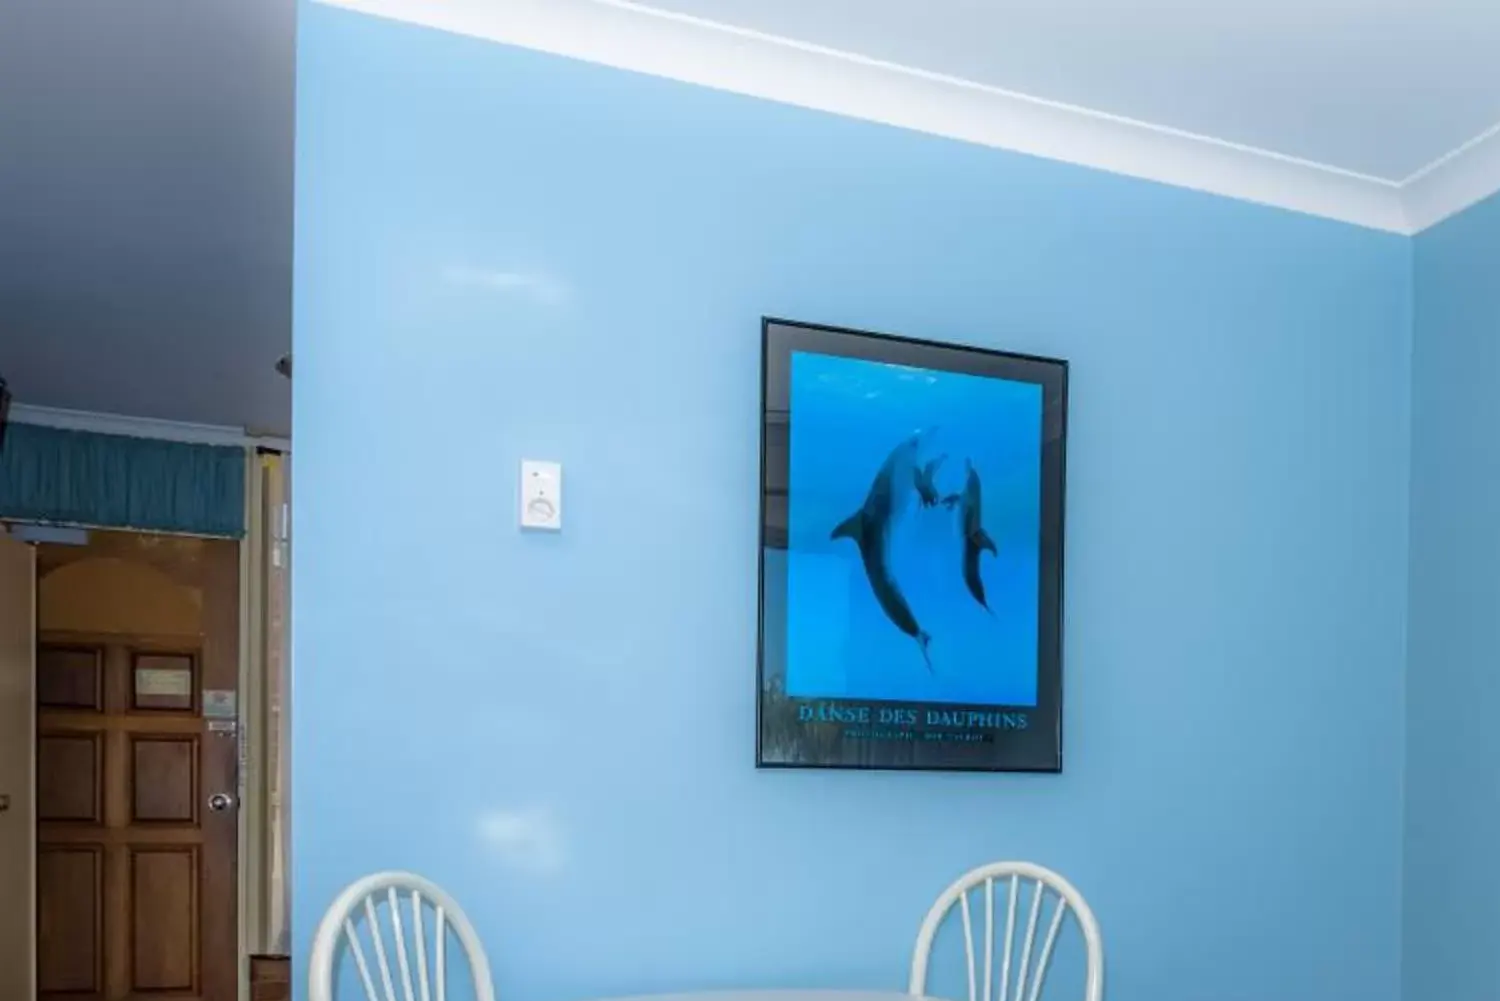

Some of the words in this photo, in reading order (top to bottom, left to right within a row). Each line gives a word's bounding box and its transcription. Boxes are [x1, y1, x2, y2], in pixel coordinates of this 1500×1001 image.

[799, 705, 870, 723] DANSE
[880, 708, 917, 724] DES
[926, 710, 1029, 729] DAUPHINS
